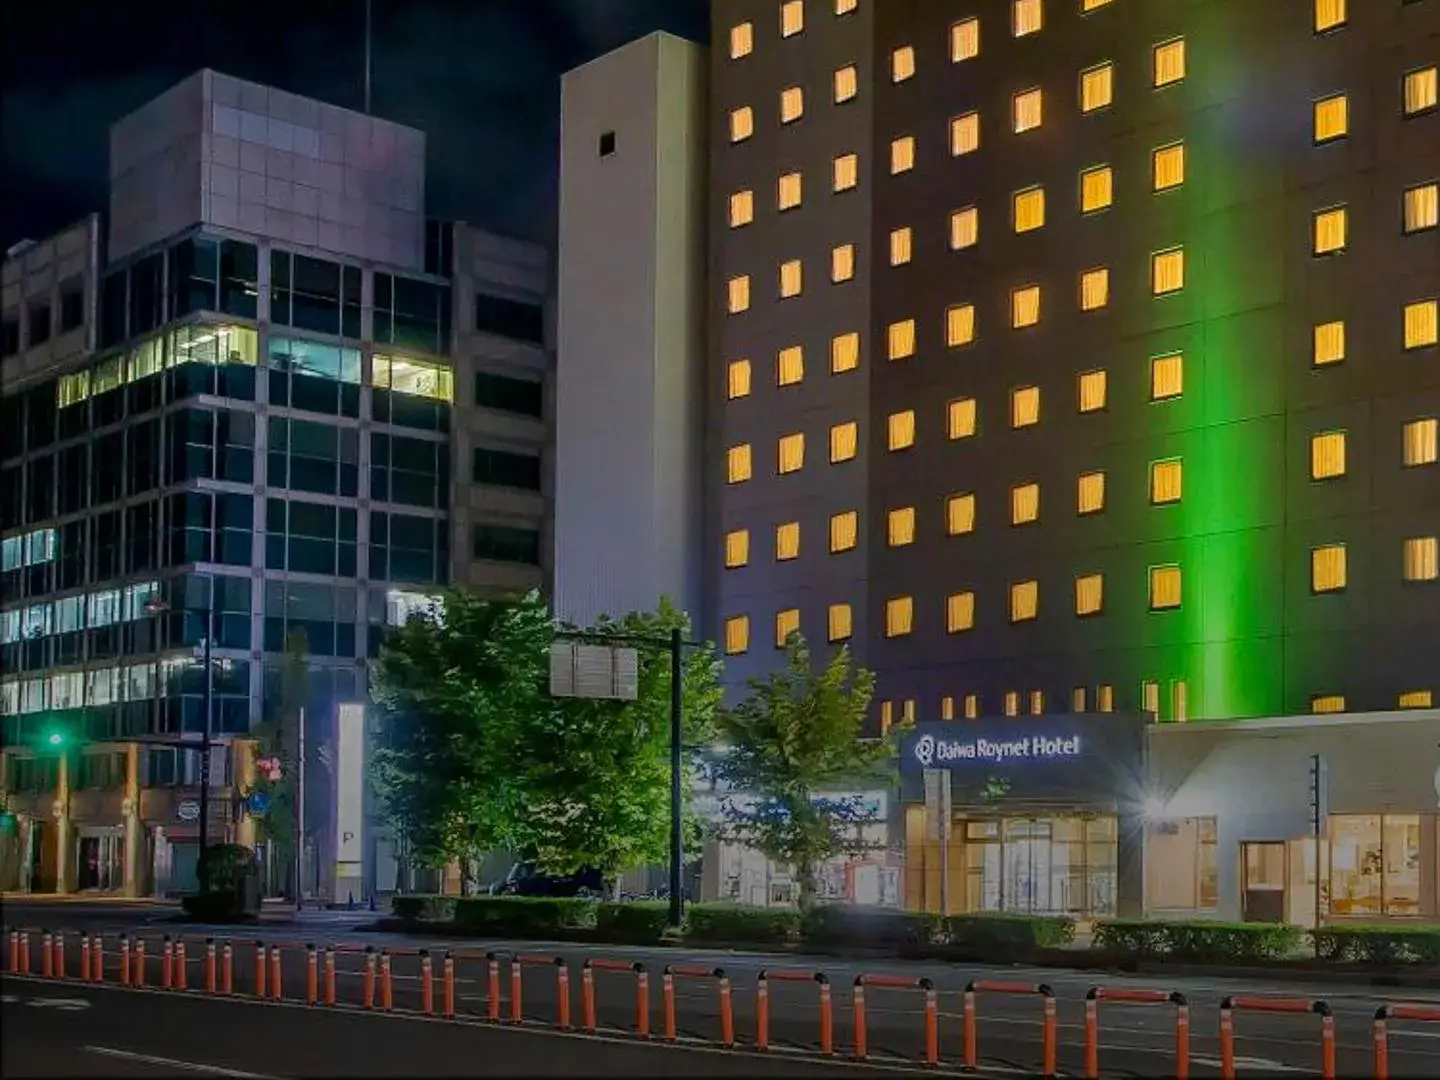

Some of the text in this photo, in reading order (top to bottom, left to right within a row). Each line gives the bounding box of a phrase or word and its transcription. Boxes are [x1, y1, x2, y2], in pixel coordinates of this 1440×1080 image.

[936, 738, 977, 759] Daiwa
[977, 735, 1030, 762] Roynet
[1032, 735, 1080, 756] Hotel
[343, 831, 354, 845] P
